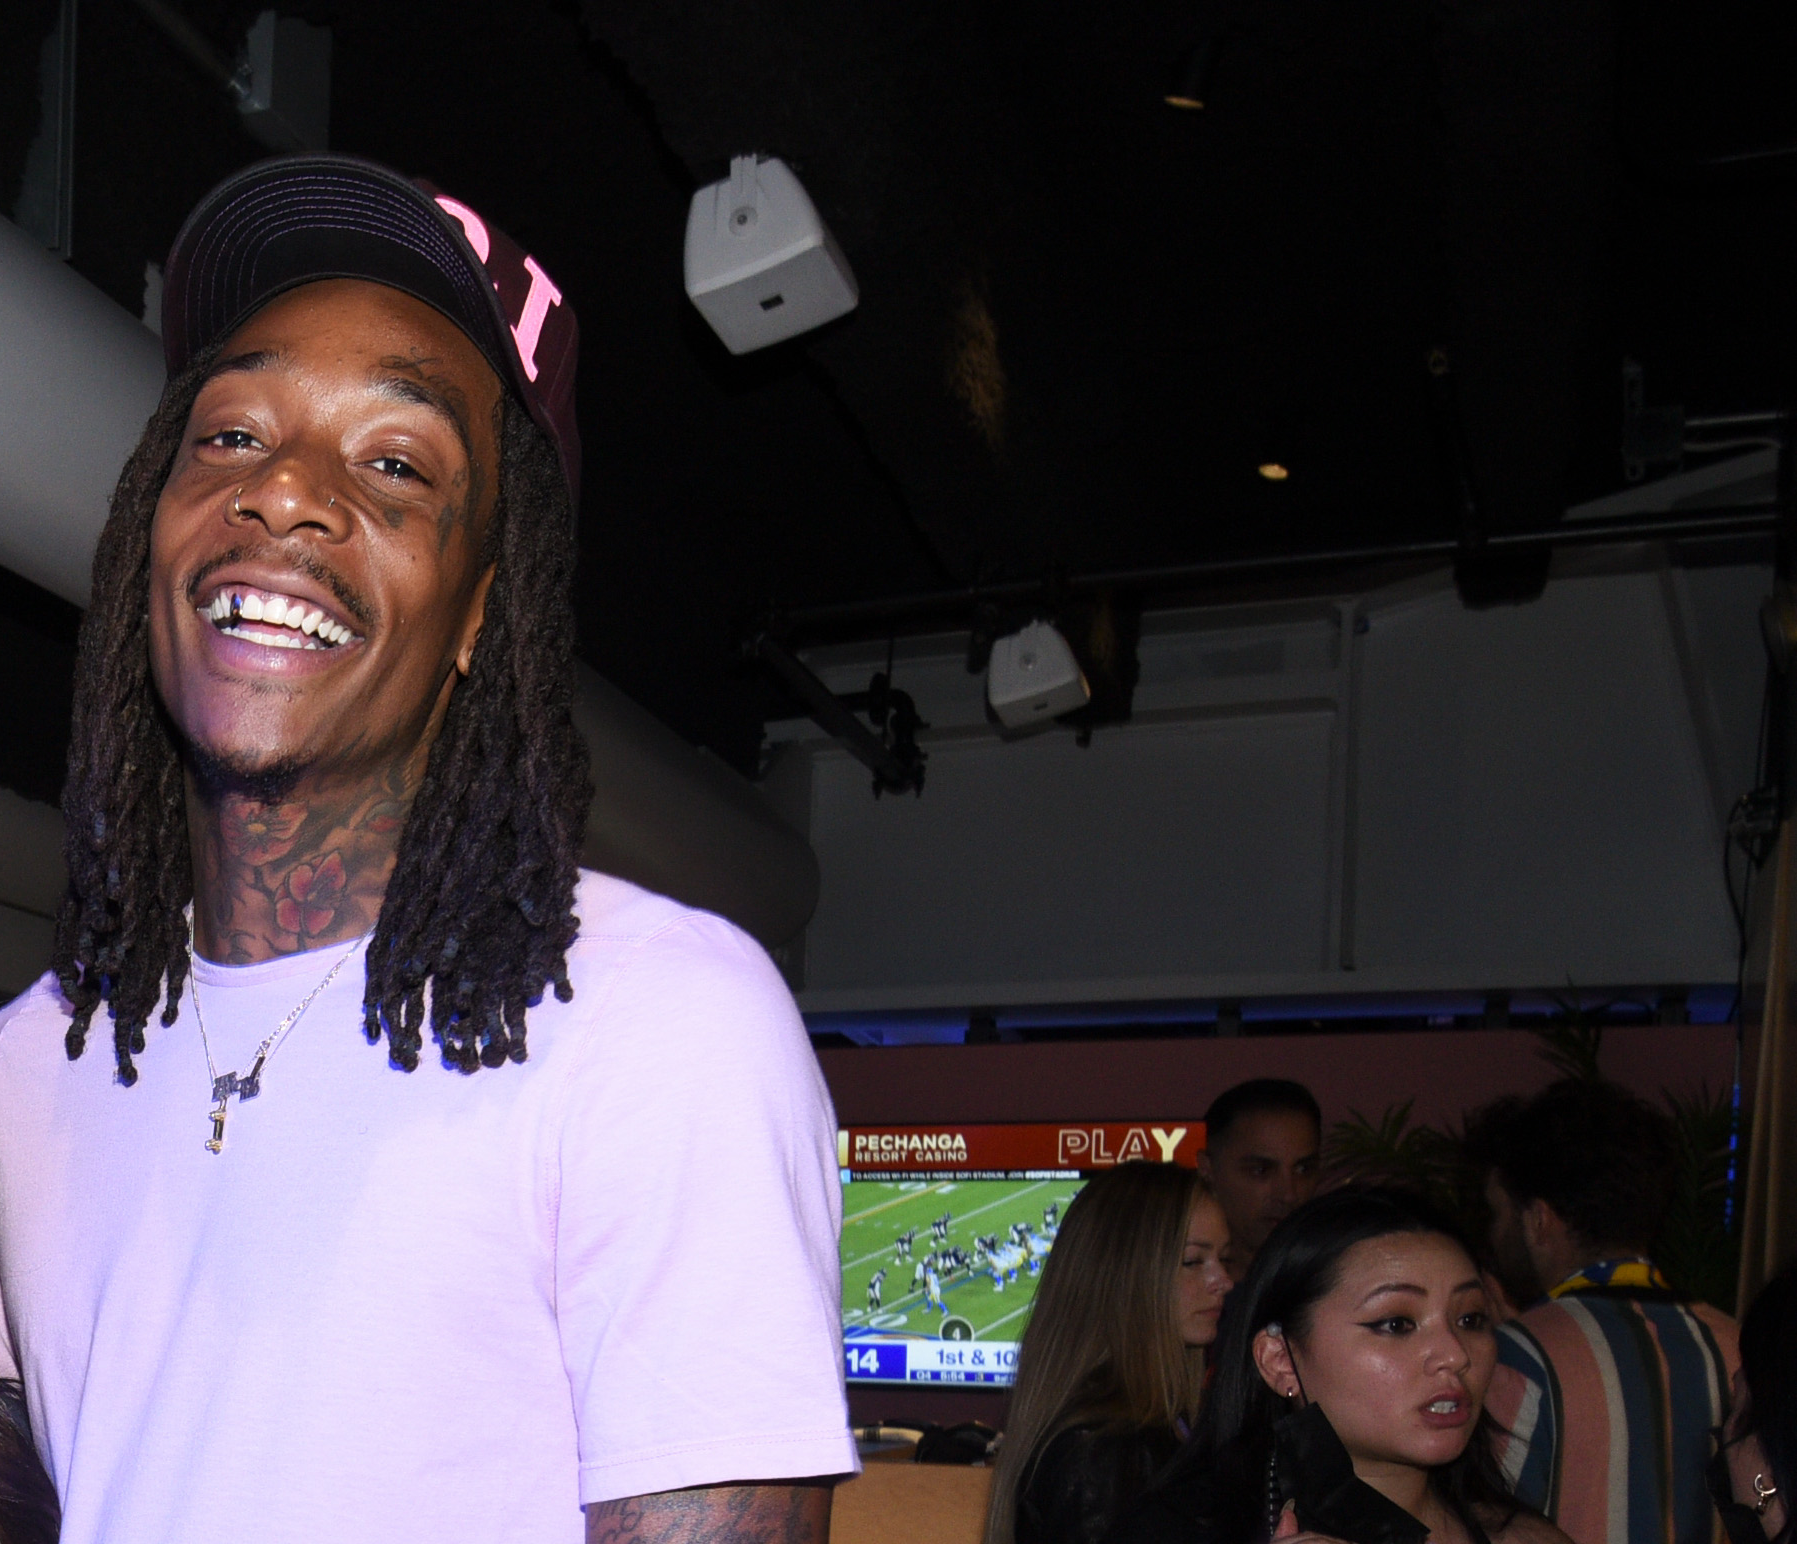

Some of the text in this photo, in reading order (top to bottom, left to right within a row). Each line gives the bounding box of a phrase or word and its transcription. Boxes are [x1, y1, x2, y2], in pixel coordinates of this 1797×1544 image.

[855, 1133, 967, 1150] PECHANGA
[1058, 1127, 1187, 1164] PLAY
[855, 1150, 968, 1162] RESORT CASINO
[863, 1172, 891, 1180] ACCESS
[846, 1348, 880, 1374] 14
[937, 1348, 964, 1364] 1st
[971, 1349, 985, 1365] &
